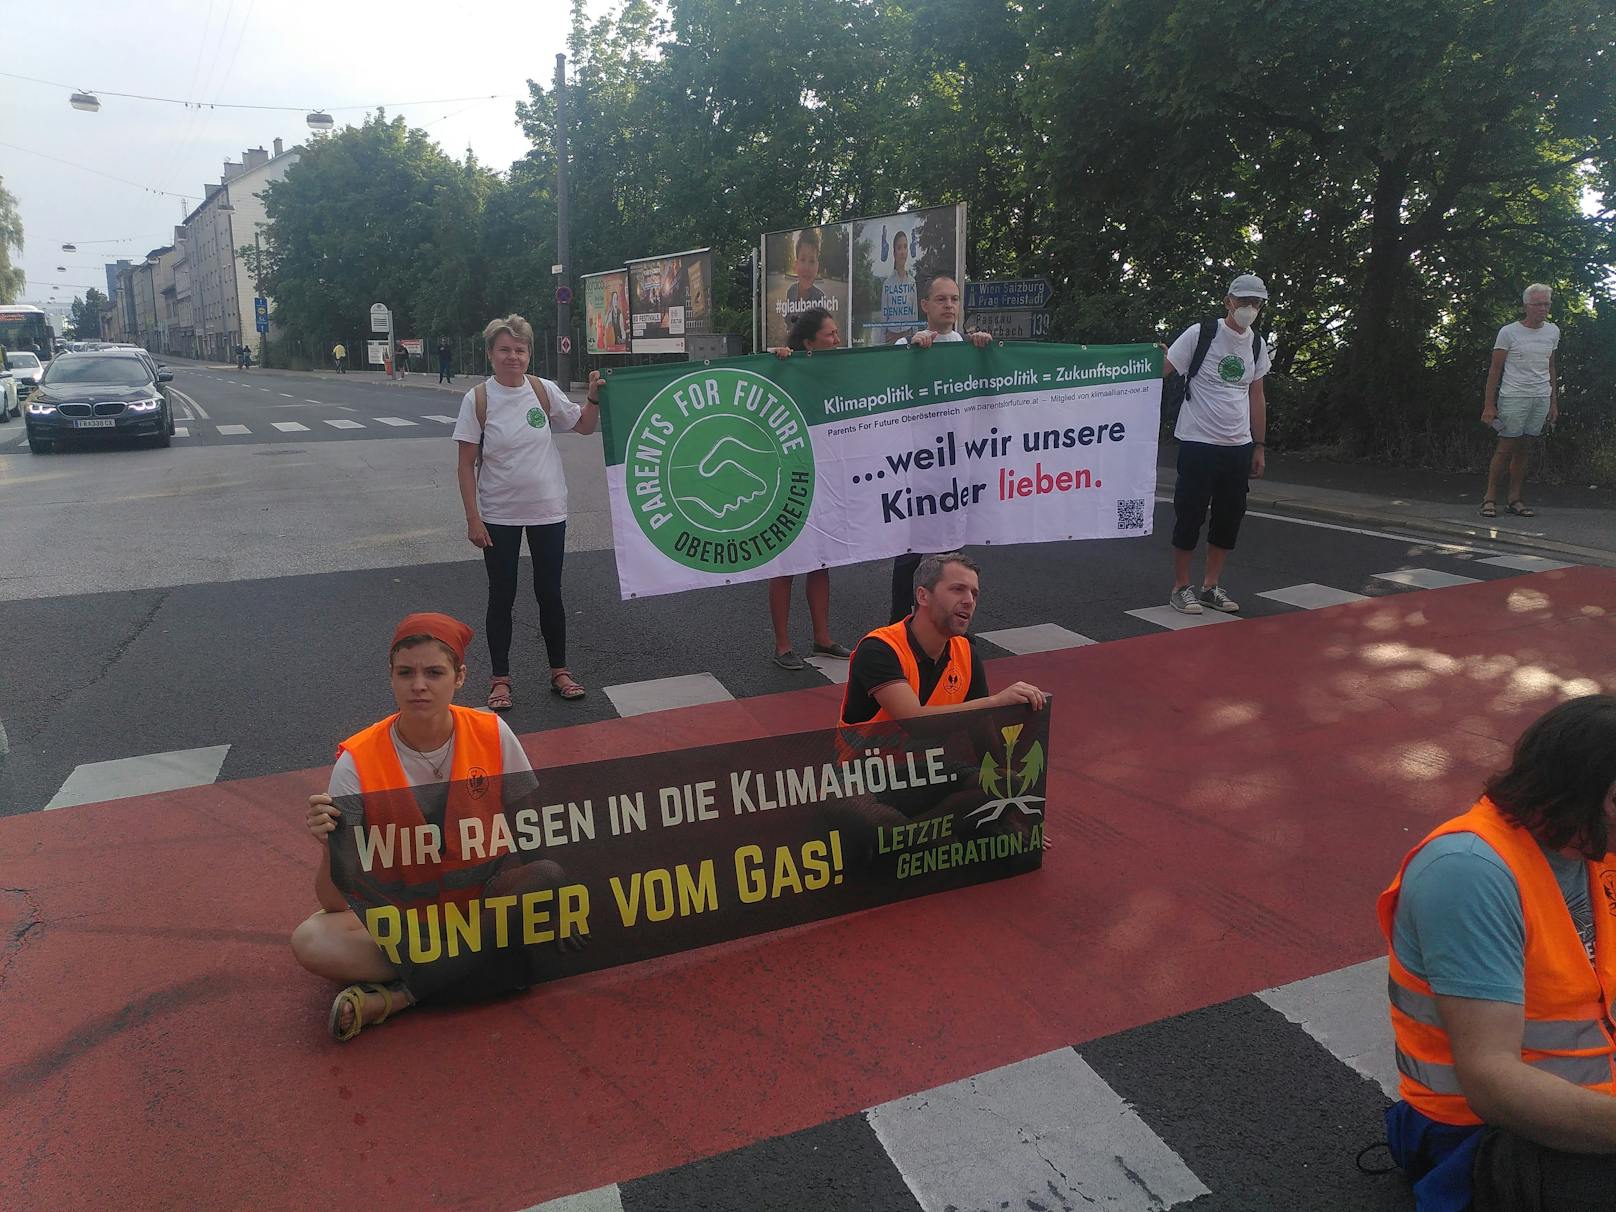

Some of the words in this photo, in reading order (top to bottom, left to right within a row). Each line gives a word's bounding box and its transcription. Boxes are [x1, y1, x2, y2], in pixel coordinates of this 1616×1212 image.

[775, 295, 839, 318] #glaubandich
[884, 283, 915, 294] PLASTIK
[891, 295, 908, 305] NEU
[978, 296, 999, 307] Prag
[1001, 293, 1044, 305] Freistadt
[980, 283, 1000, 294] Wien
[1004, 281, 1045, 294] Salzburg
[883, 306, 916, 317] DENKEN.
[976, 313, 1012, 324] Passau
[1032, 313, 1050, 336] 139
[824, 384, 914, 415] Klimapolitik
[933, 368, 1038, 398] Friedenspolitik
[1056, 357, 1152, 382] Zukunftspolitik
[827, 424, 856, 437] Parents
[859, 421, 872, 431] For
[874, 418, 900, 428] Future
[901, 407, 961, 423] Oberösterreich
[1050, 392, 1075, 403] Mitglied
[1078, 392, 1089, 400] von
[634, 412, 675, 531] PARENTS
[672, 378, 721, 417] FOR
[733, 379, 805, 455] FUTURE
[964, 427, 1013, 460] wir
[1023, 421, 1126, 453] unsere
[881, 477, 987, 524] Kinder
[999, 463, 1102, 501] lieben.
[674, 470, 809, 565] OBERÖSTERREICH
[354, 822, 442, 873] WIR
[458, 799, 596, 862] RASEN
[608, 791, 647, 836] IN
[658, 780, 720, 828] DIE
[730, 747, 957, 815] KLIMAHÖLLE.
[877, 813, 955, 855] LETZTE
[365, 883, 591, 965] RUNTER
[609, 859, 720, 928] VOM
[734, 829, 844, 904] GAS!
